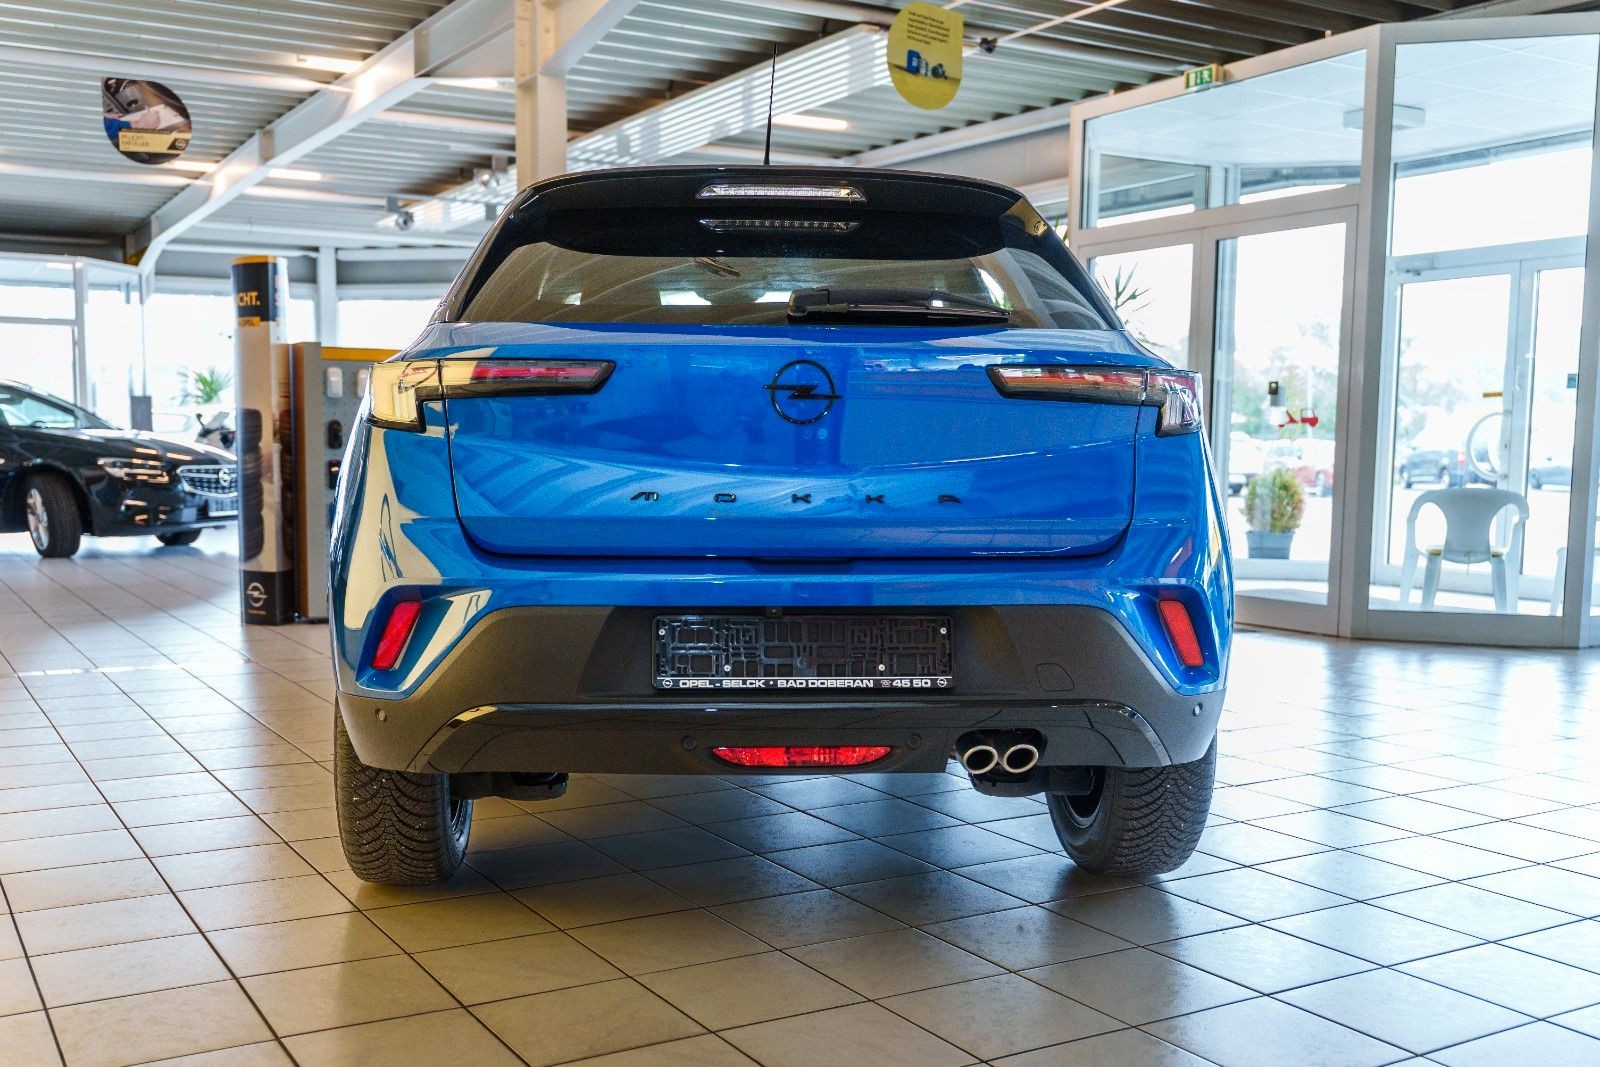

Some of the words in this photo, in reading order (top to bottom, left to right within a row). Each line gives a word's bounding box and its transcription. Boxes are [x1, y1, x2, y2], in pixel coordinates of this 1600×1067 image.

[630, 491, 962, 504] MOKKA
[777, 679, 806, 688] BAD
[808, 679, 874, 688] DOBERAN
[892, 679, 911, 688] 45
[912, 679, 931, 688] 50
